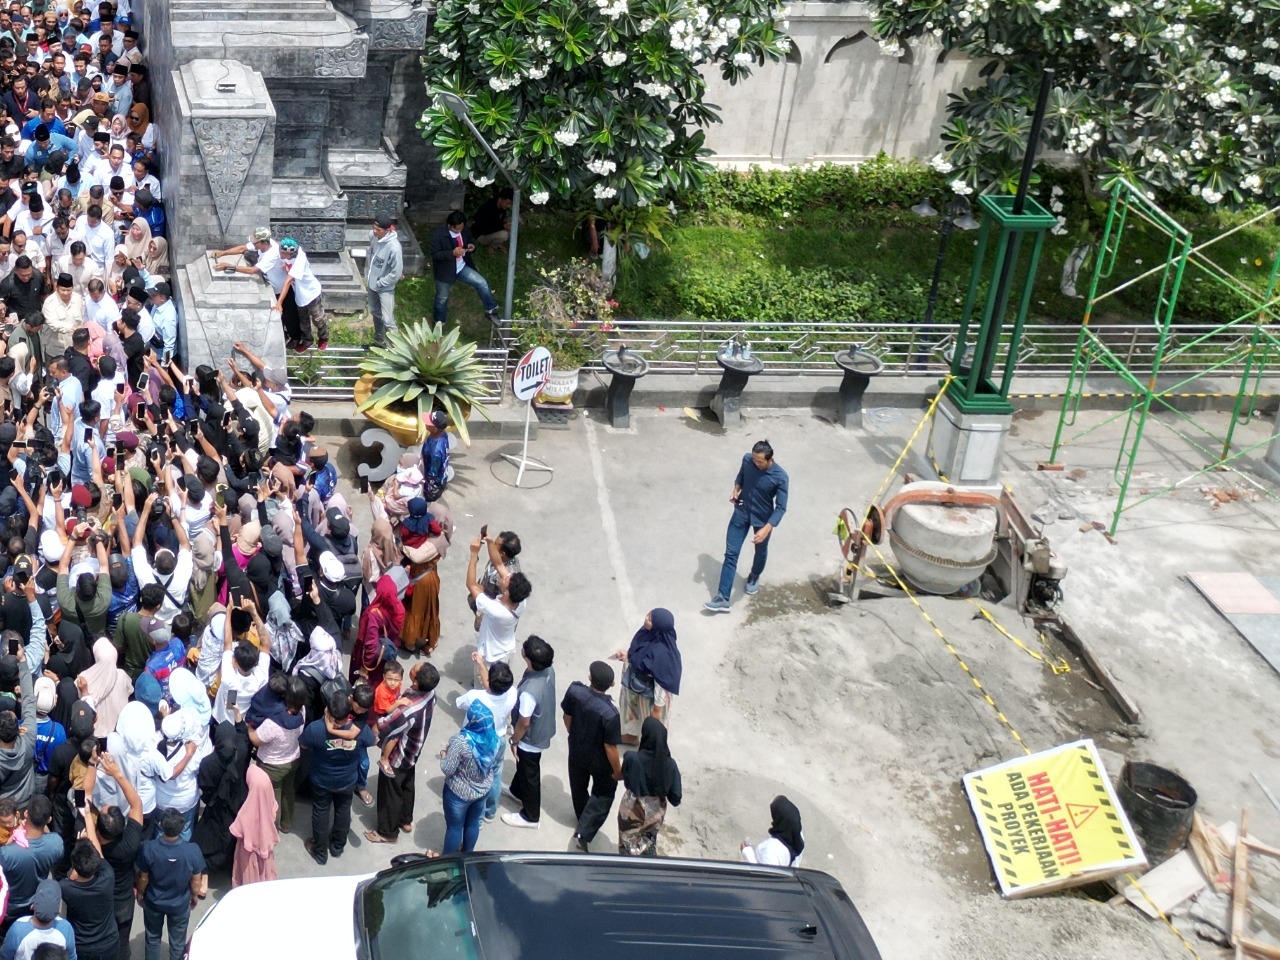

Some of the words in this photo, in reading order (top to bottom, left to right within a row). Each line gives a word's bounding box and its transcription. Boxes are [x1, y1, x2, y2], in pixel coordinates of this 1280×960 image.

[521, 356, 550, 382] TOILET
[997, 802, 1031, 855] PROYEK
[1006, 772, 1030, 802] ADA
[1018, 802, 1061, 879] PEKERJAAN
[1027, 771, 1083, 867] HATI-HATI!
